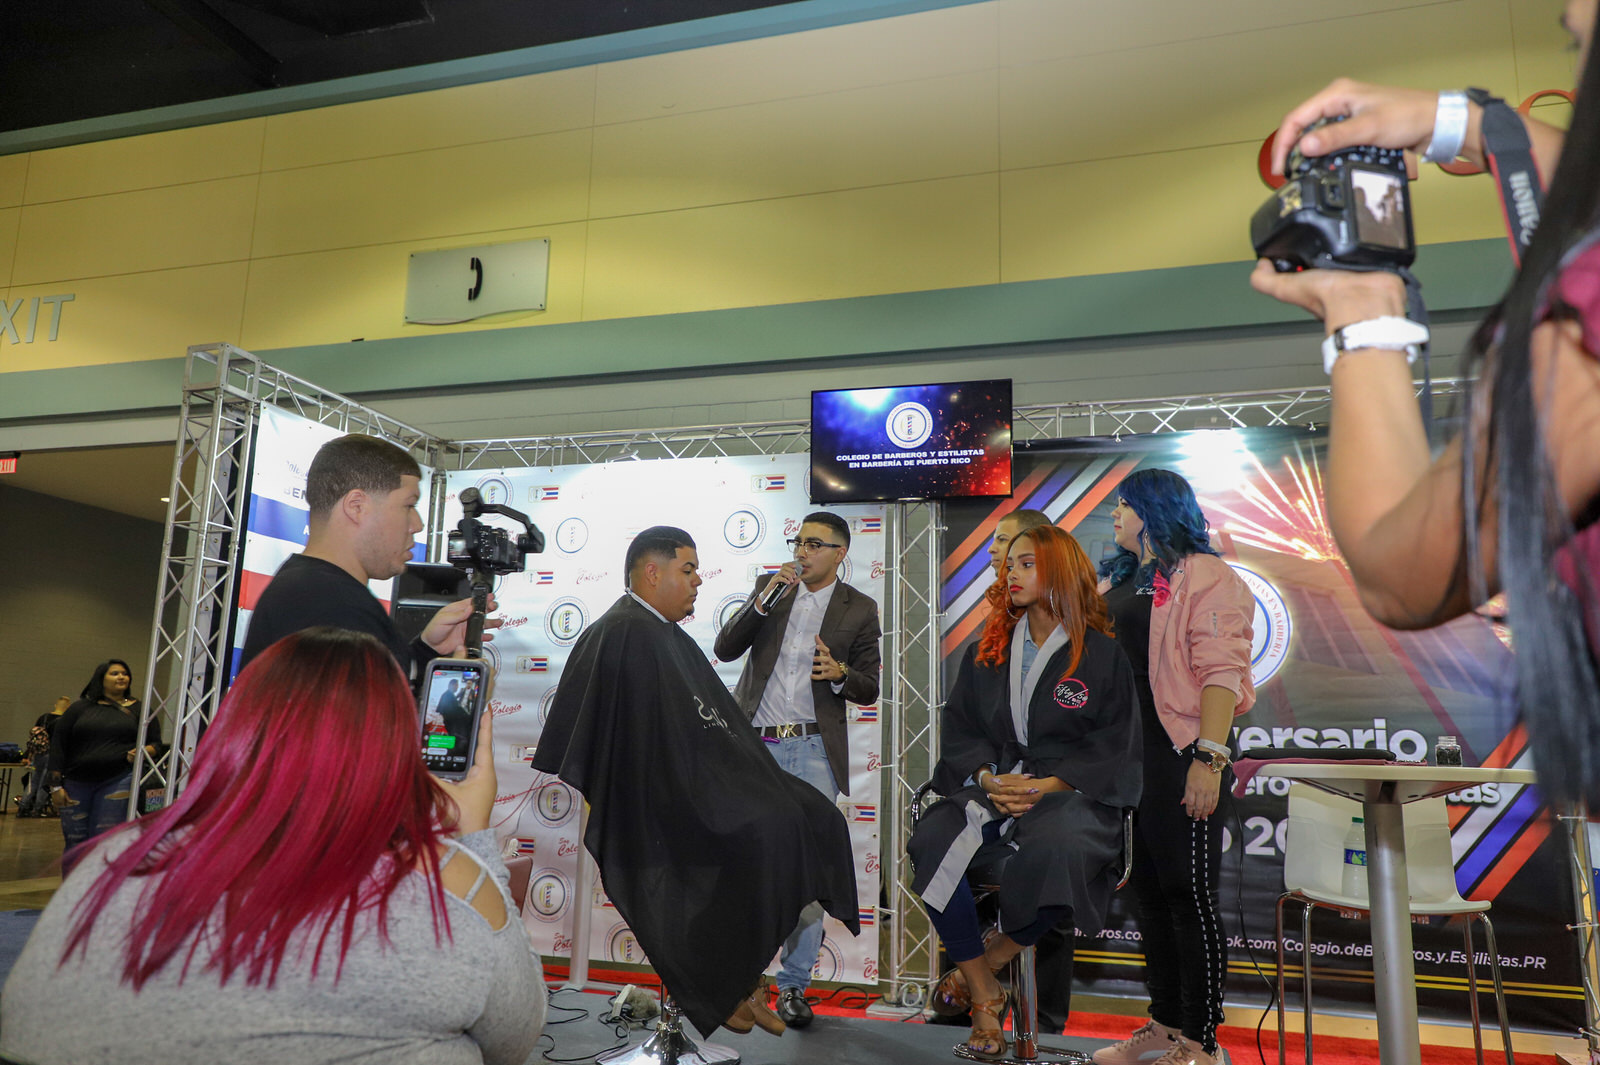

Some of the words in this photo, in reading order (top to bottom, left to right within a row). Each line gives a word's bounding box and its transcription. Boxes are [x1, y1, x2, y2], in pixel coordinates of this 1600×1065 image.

[836, 454, 870, 462] COLEGIO
[884, 451, 928, 460] BARBEROS
[937, 448, 985, 457] ESTILISTAS
[849, 461, 861, 469] EN
[861, 459, 903, 468] BARBERÍA
[904, 458, 915, 466] DE
[916, 457, 949, 465] PUERTO
[950, 456, 971, 464] RICO
[1233, 718, 1428, 763] ersario
